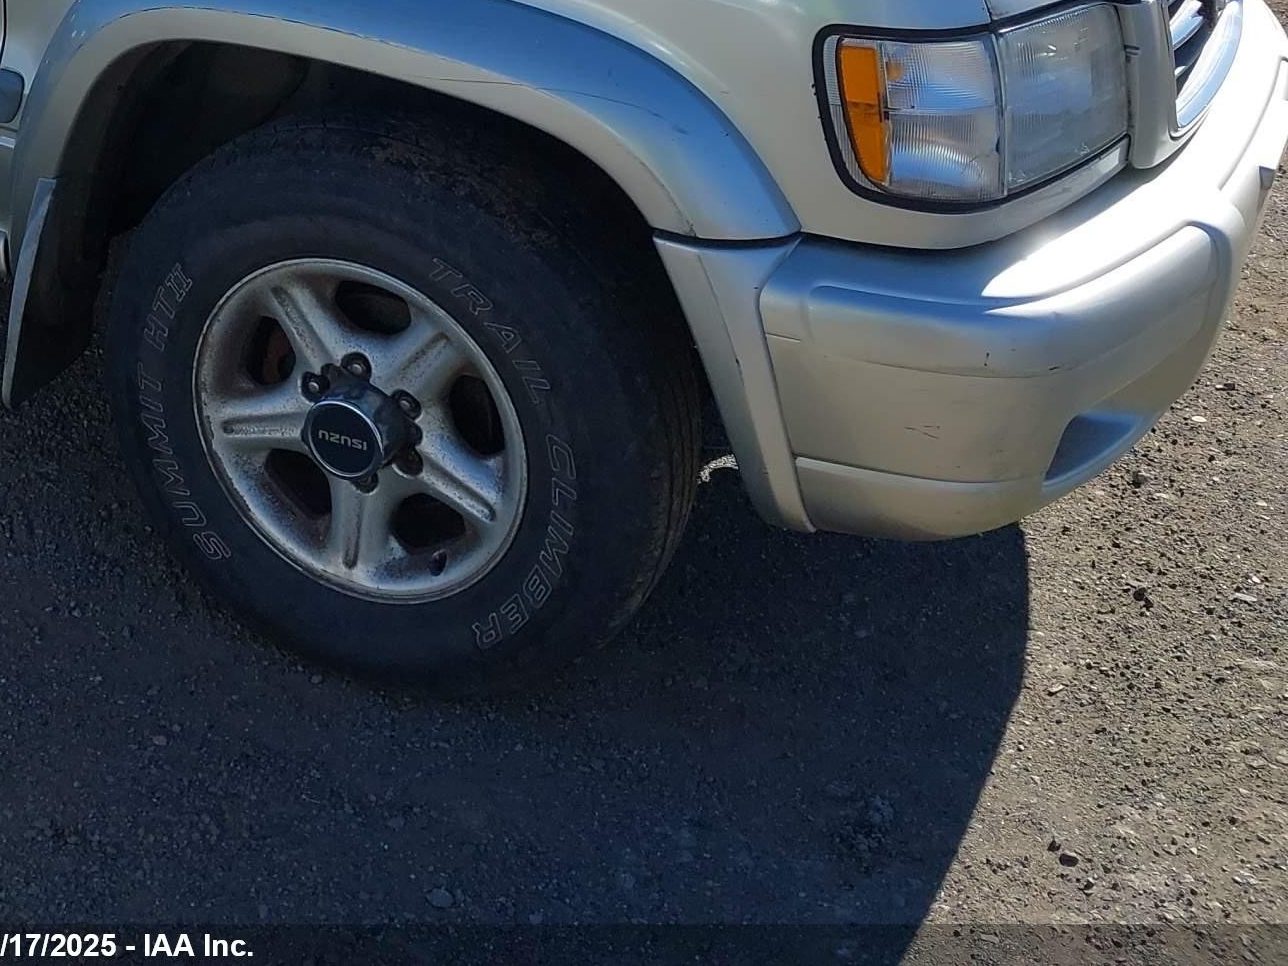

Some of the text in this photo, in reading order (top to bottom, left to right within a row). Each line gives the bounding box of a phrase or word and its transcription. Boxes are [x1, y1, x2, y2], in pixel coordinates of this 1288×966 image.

[136, 361, 232, 561] SUMMIT
[317, 429, 368, 451] ISUZU
[429, 256, 578, 651] TRAIL CLIMBER
